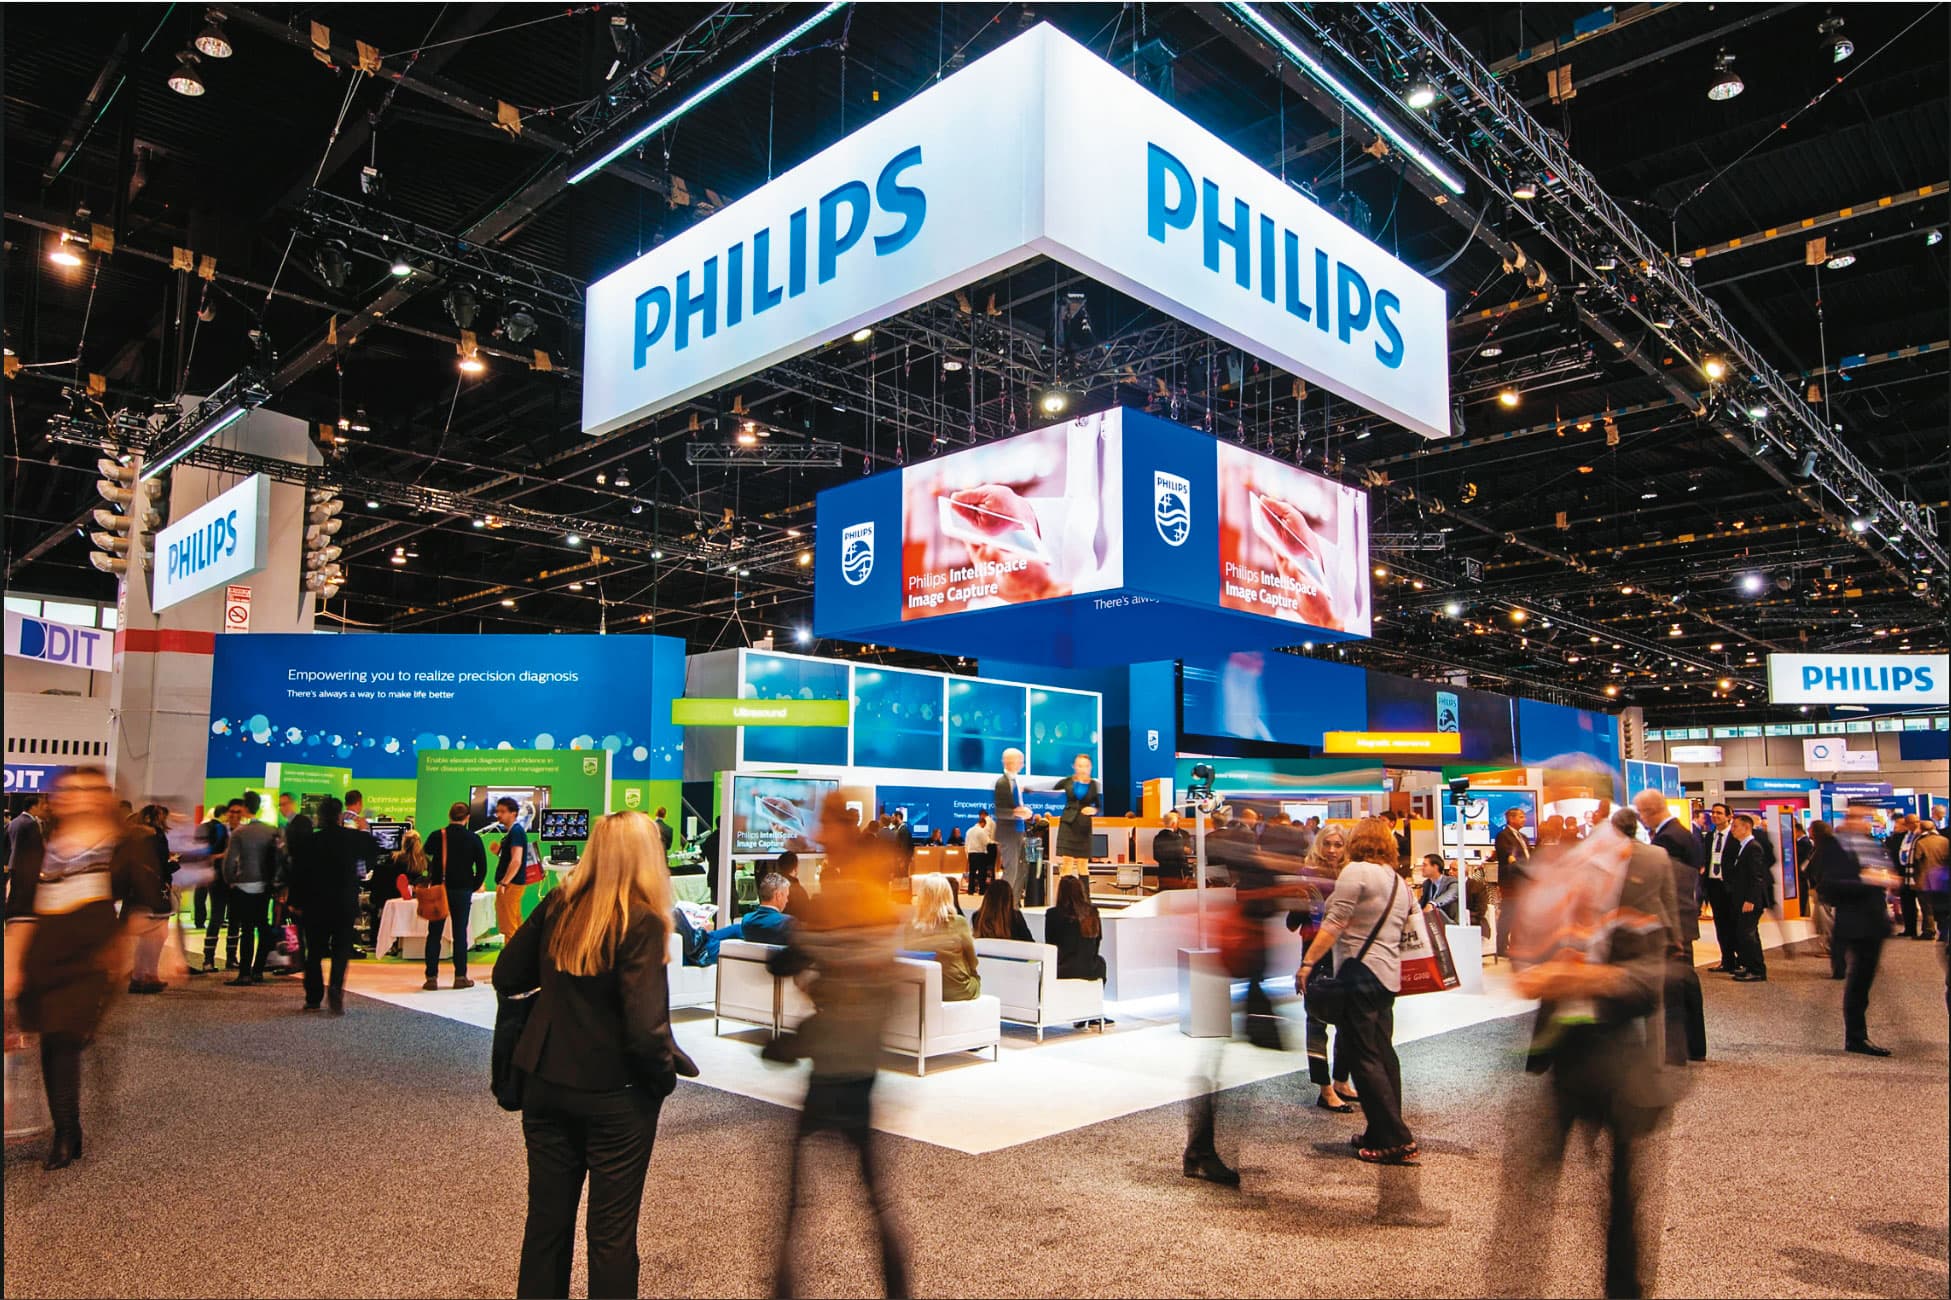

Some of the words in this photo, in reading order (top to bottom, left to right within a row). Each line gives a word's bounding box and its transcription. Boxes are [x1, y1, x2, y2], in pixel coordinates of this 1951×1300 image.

[634, 145, 926, 370] PHILIPS
[1148, 141, 1404, 369] PHILIPS
[1157, 476, 1188, 494] PHILIPS
[844, 526, 872, 540] PHILIPS
[168, 509, 237, 584] PHILIPS
[909, 573, 946, 590] Philips
[949, 560, 1027, 583] IntelliSpace
[1226, 561, 1259, 583] Philips
[1261, 570, 1317, 596] IntelliSpace
[908, 592, 944, 608] Image
[947, 583, 998, 602] Capture
[1094, 596, 1129, 610] There's
[1225, 580, 1257, 603] Image
[1259, 588, 1298, 610] Capture
[288, 669, 367, 683] Empowering
[371, 672, 395, 683] you
[398, 671, 411, 681] to
[414, 670, 454, 681] realize
[458, 670, 516, 683] precision
[519, 670, 579, 684] diagnosis
[1802, 666, 1934, 692] PHILIPS
[287, 689, 317, 698] There's
[318, 690, 348, 699] always
[377, 690, 387, 698] to
[388, 690, 412, 698] make
[413, 690, 427, 698] life
[428, 690, 454, 698] better
